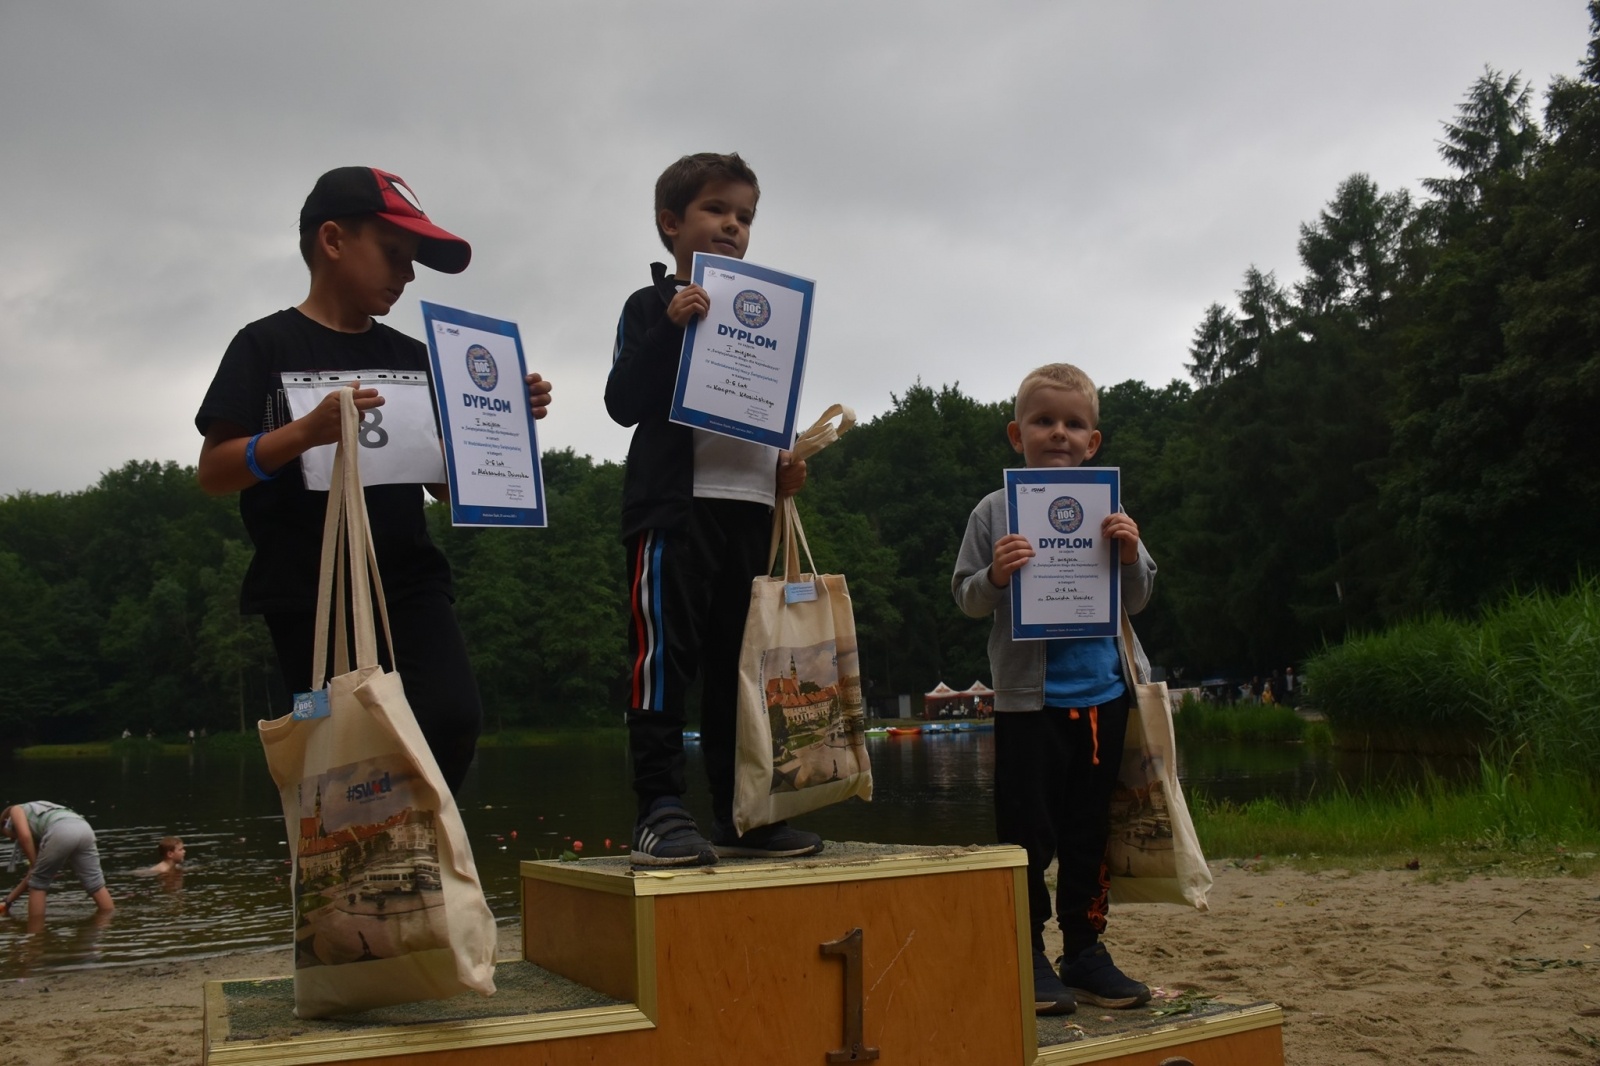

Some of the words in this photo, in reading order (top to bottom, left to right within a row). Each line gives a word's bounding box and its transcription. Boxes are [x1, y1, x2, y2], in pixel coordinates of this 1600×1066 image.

[718, 324, 777, 350] DYPLOM
[463, 393, 511, 413] DYPLOM
[358, 408, 388, 448] 8
[1039, 538, 1092, 548] DYPLOM
[819, 927, 880, 1062] 1
